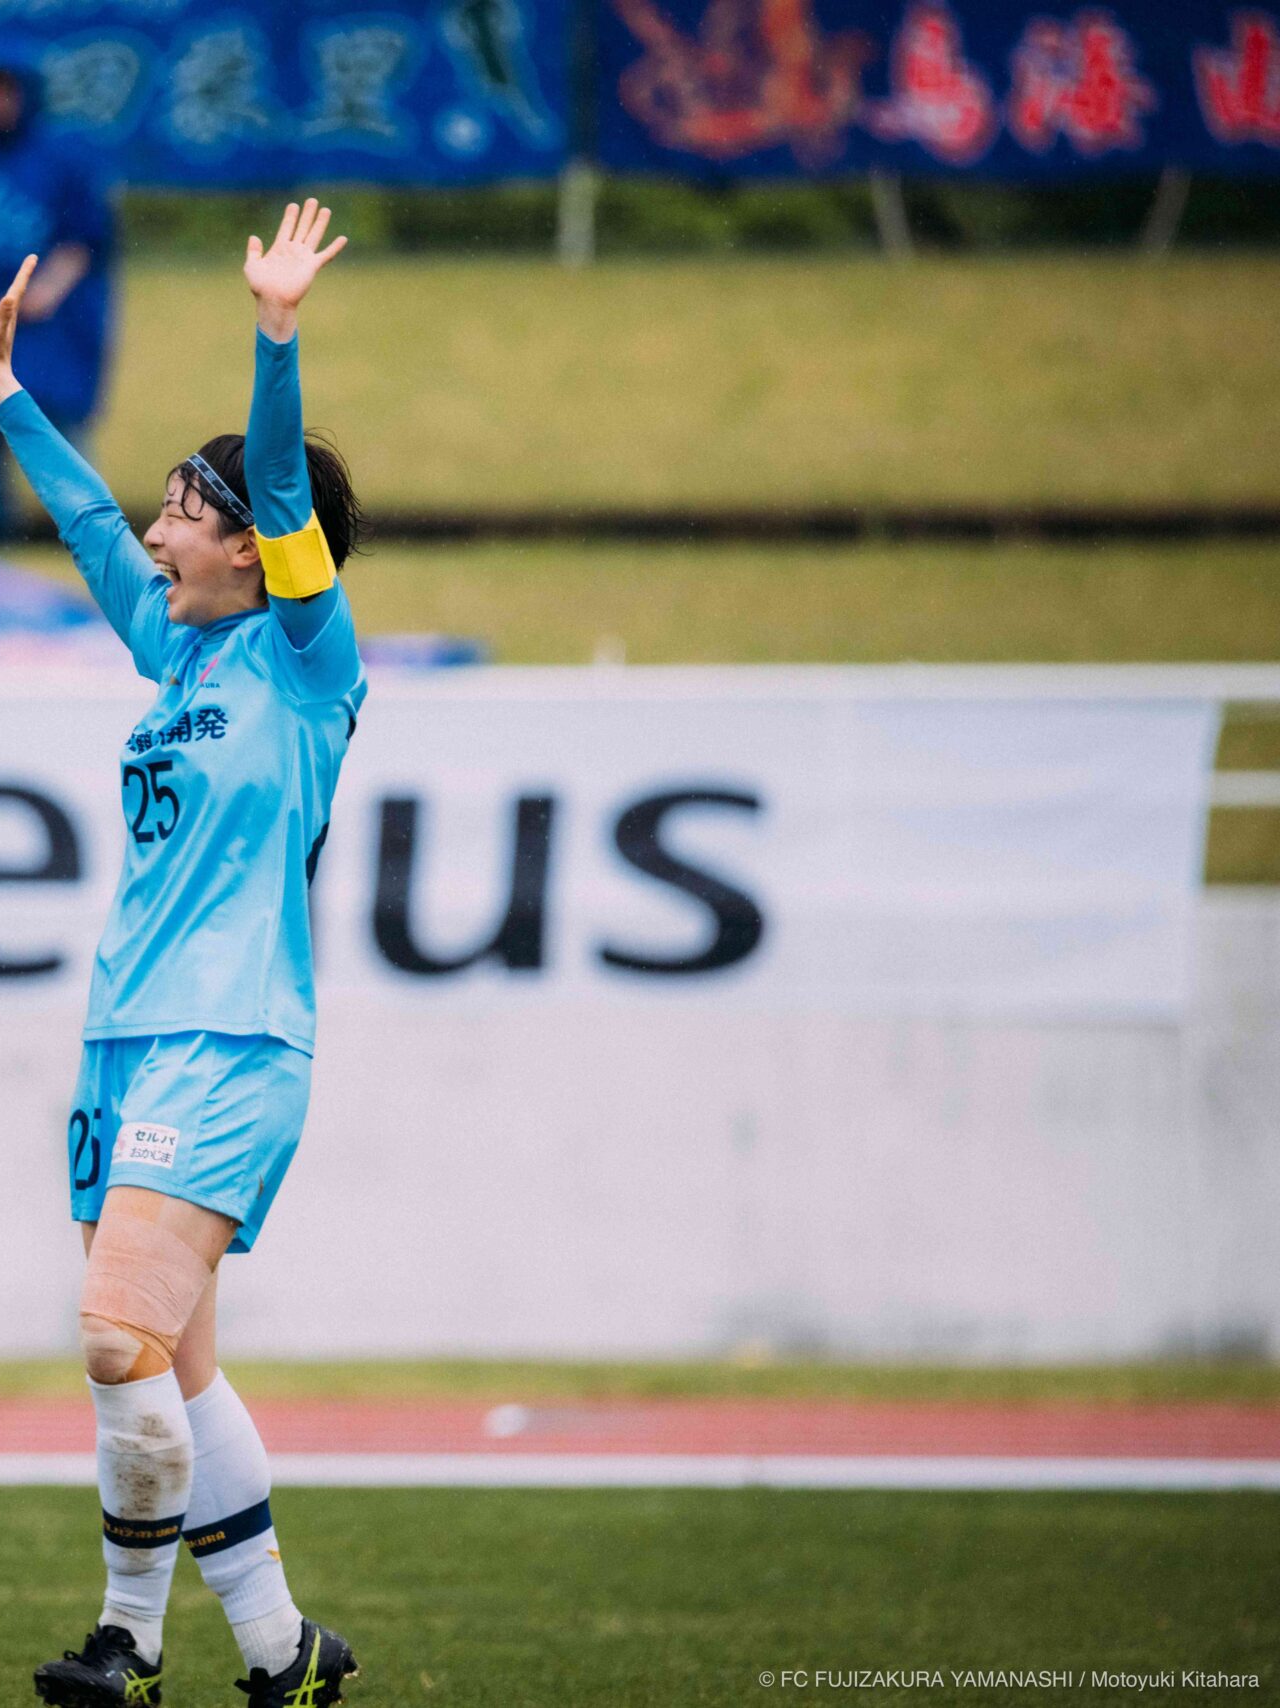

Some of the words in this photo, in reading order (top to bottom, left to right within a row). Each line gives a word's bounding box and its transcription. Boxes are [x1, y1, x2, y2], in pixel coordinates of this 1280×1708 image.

[123, 760, 180, 843] 25
[135, 1130, 176, 1146] セルバ
